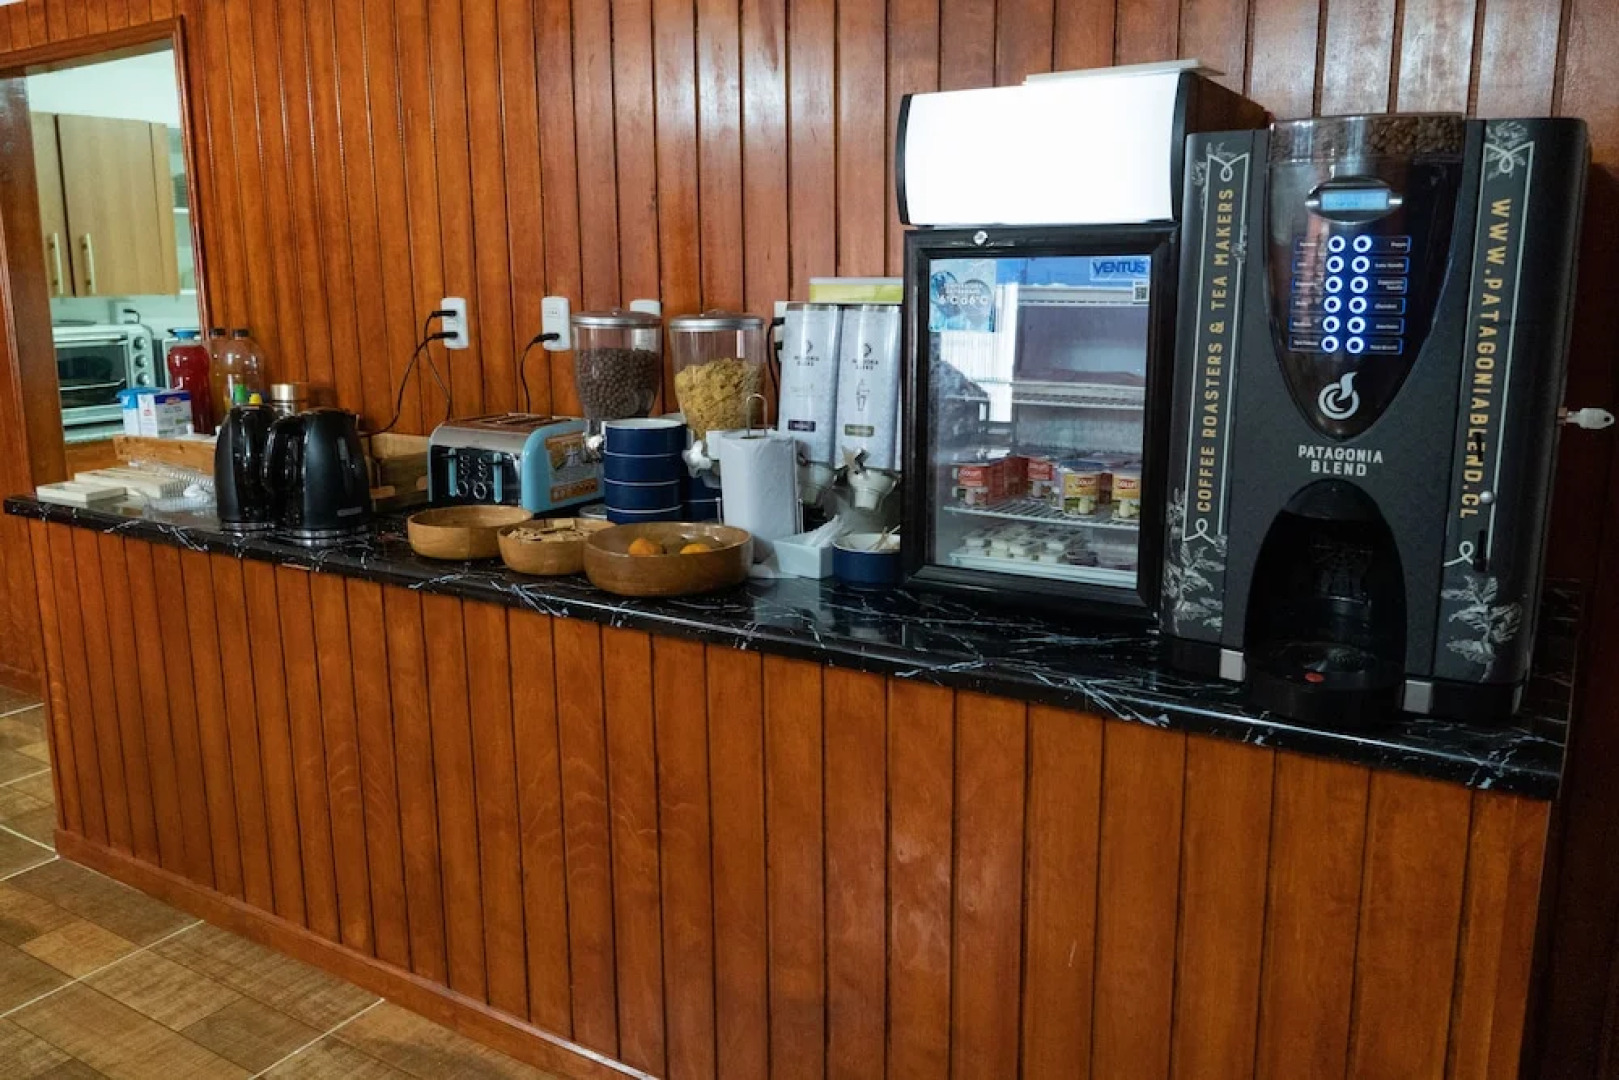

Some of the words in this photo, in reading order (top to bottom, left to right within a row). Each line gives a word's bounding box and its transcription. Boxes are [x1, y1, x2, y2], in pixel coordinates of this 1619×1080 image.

[1214, 189, 1234, 266] MAKERS
[1092, 260, 1146, 275] VENTUS
[1211, 276, 1228, 311] TEA
[1209, 321, 1225, 334] &
[1459, 198, 1512, 519] WWW.PATAGONIABLEND.CL
[1202, 342, 1223, 438] ROASTERS
[1297, 444, 1384, 464] PATAGONIA
[1310, 460, 1368, 477] BLEND
[1197, 446, 1215, 512] COFFEE
